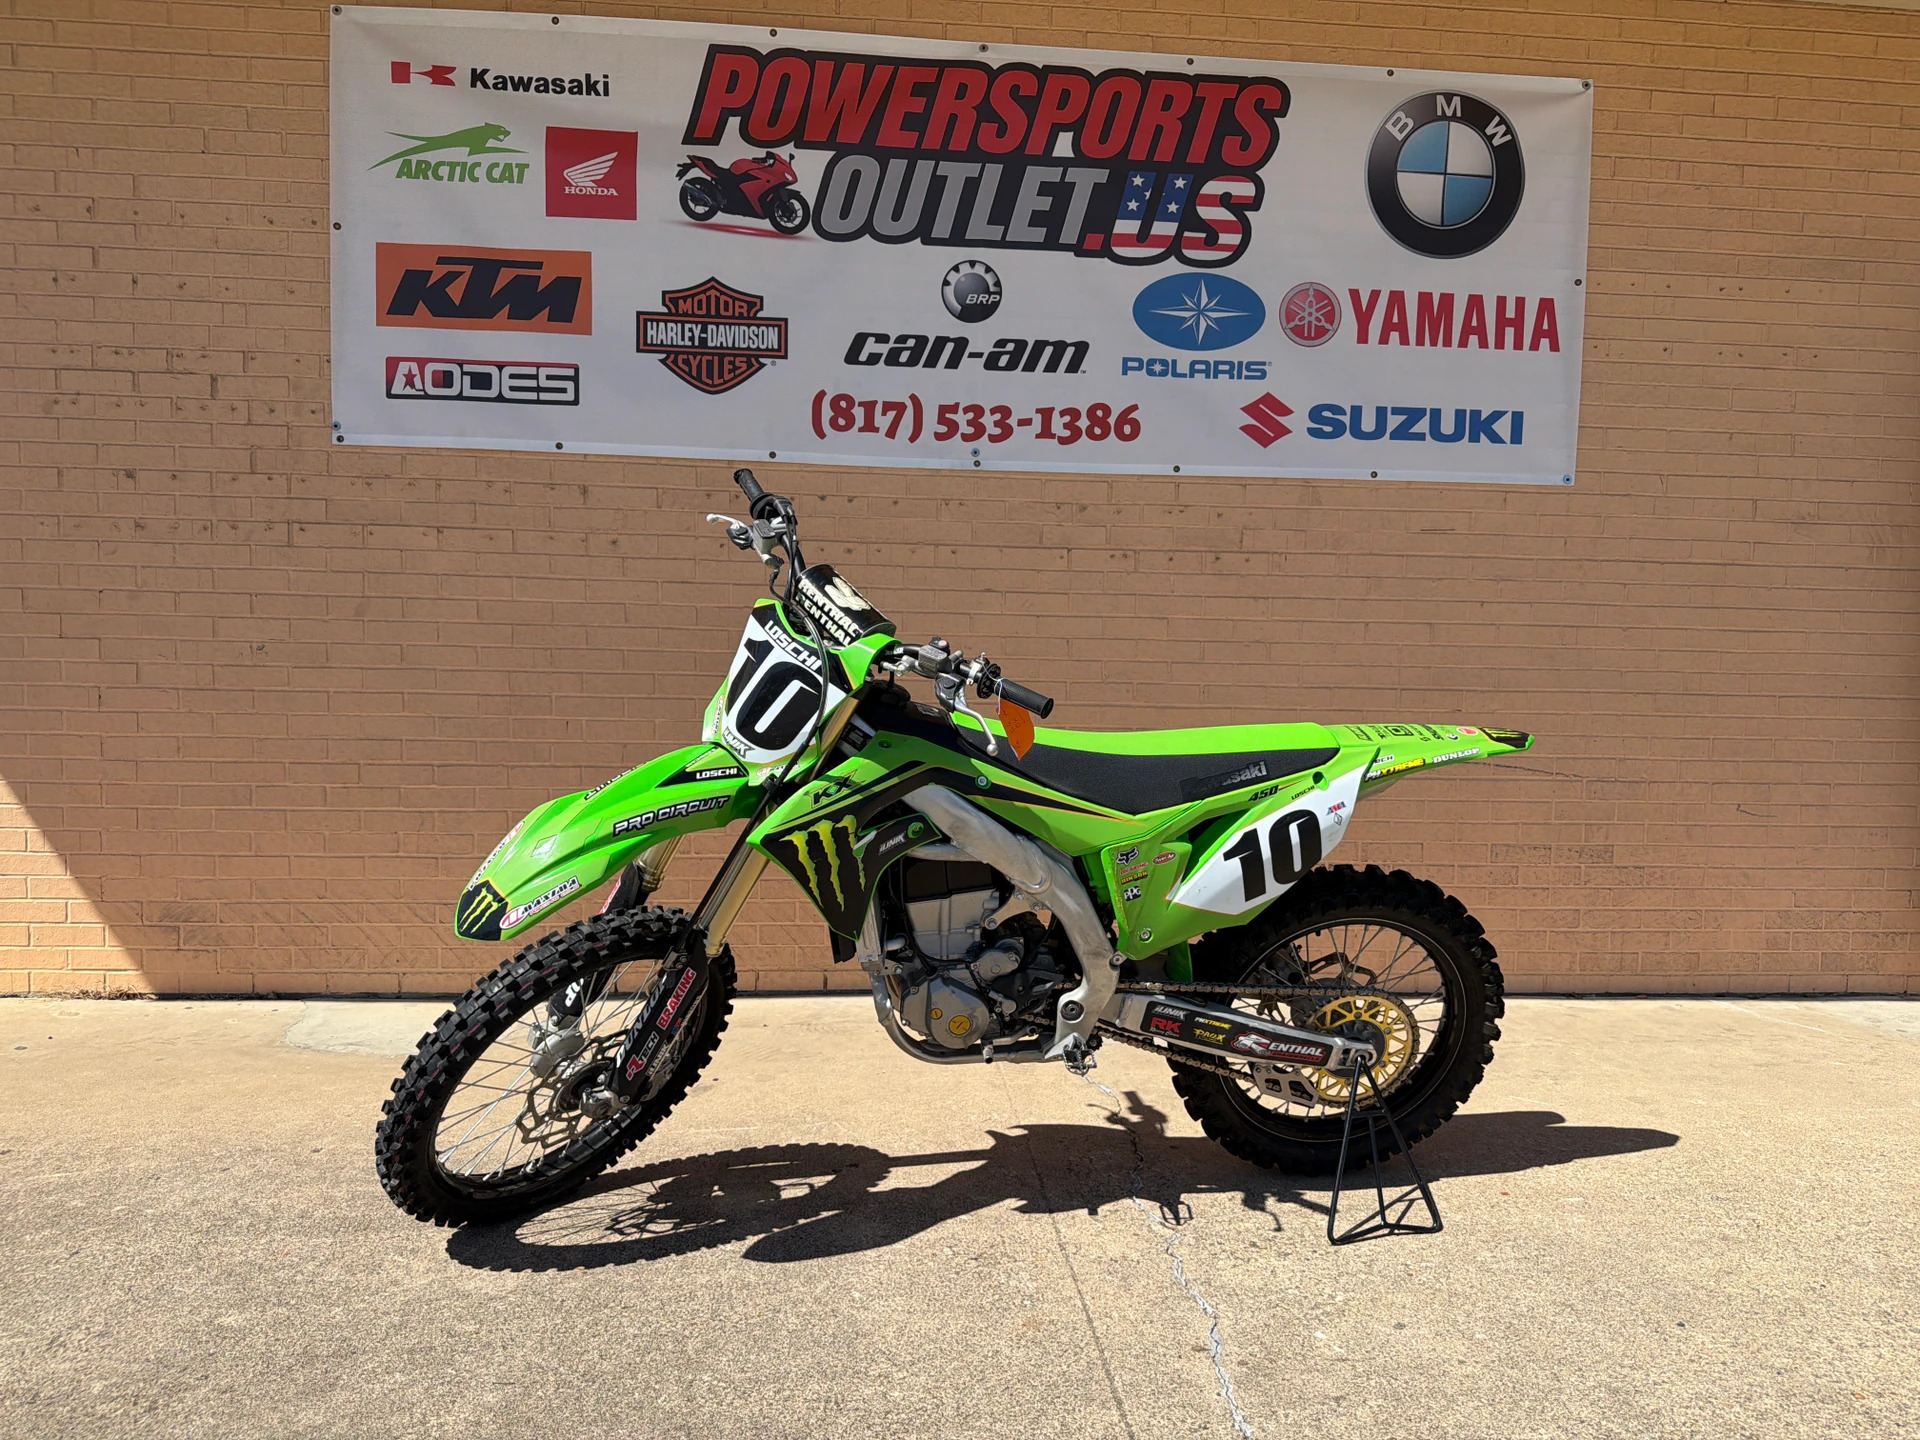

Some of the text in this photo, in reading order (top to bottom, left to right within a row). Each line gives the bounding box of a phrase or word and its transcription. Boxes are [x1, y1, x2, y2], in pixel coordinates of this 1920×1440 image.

[470, 68, 610, 97] Kawasaki
[684, 45, 1290, 168] POWERSPORTS
[1384, 94, 1513, 149] BMW
[395, 158, 530, 184] ARCTIC CAT
[563, 186, 619, 197] HONDA
[386, 256, 582, 323] KTM
[677, 291, 748, 317] MOTOR
[966, 293, 1001, 305] BRP
[646, 321, 778, 350] HARLEY-DAVIDSON
[1347, 287, 1561, 353] YAMAHA
[843, 330, 1090, 374] can-am
[1121, 356, 1268, 381] POLARIS
[391, 361, 576, 401] AODES
[677, 354, 749, 386] CYCLES
[811, 388, 1142, 446] (817) 533-1386
[1306, 403, 1524, 446] SUZUKI
[764, 619, 822, 671] LOSCHI
[725, 637, 824, 750] 10
[1432, 747, 1480, 764] DUNLOP
[695, 767, 738, 780] LOSCHI
[812, 771, 855, 806] KX
[1248, 785, 1280, 803] 450
[613, 795, 731, 838] PRO CIRCUIT
[1223, 809, 1323, 902] 10
[1124, 886, 1142, 901] PPG
[656, 966, 697, 1031] BRAKING
[1151, 1017, 1181, 1033] RK
